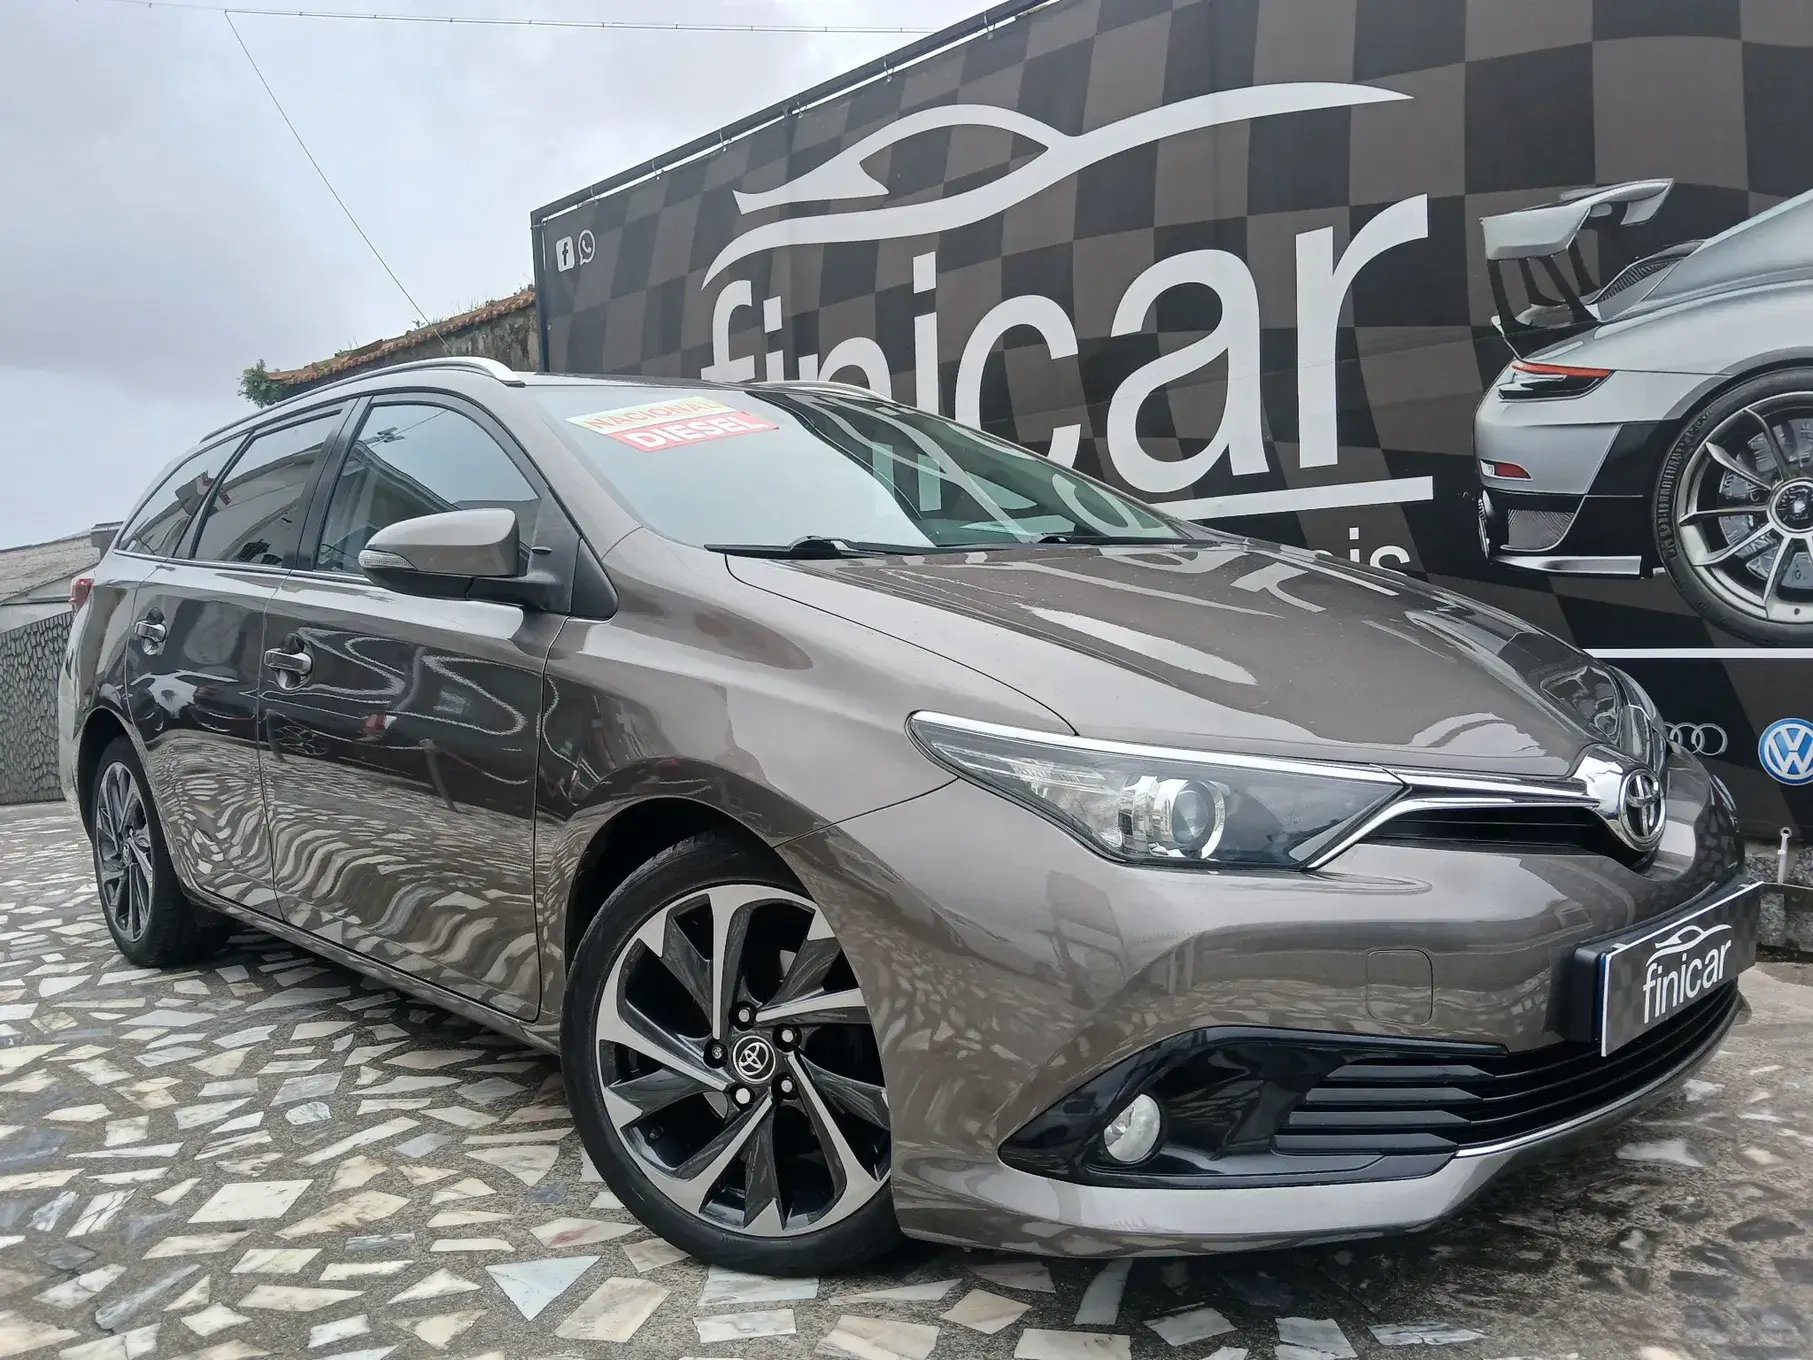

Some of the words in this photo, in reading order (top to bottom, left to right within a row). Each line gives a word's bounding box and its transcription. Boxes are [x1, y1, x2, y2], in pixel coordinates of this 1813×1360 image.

[584, 401, 723, 429] NACIONAL
[622, 415, 768, 448] DIESEL
[1643, 939, 1732, 1024] finicar
